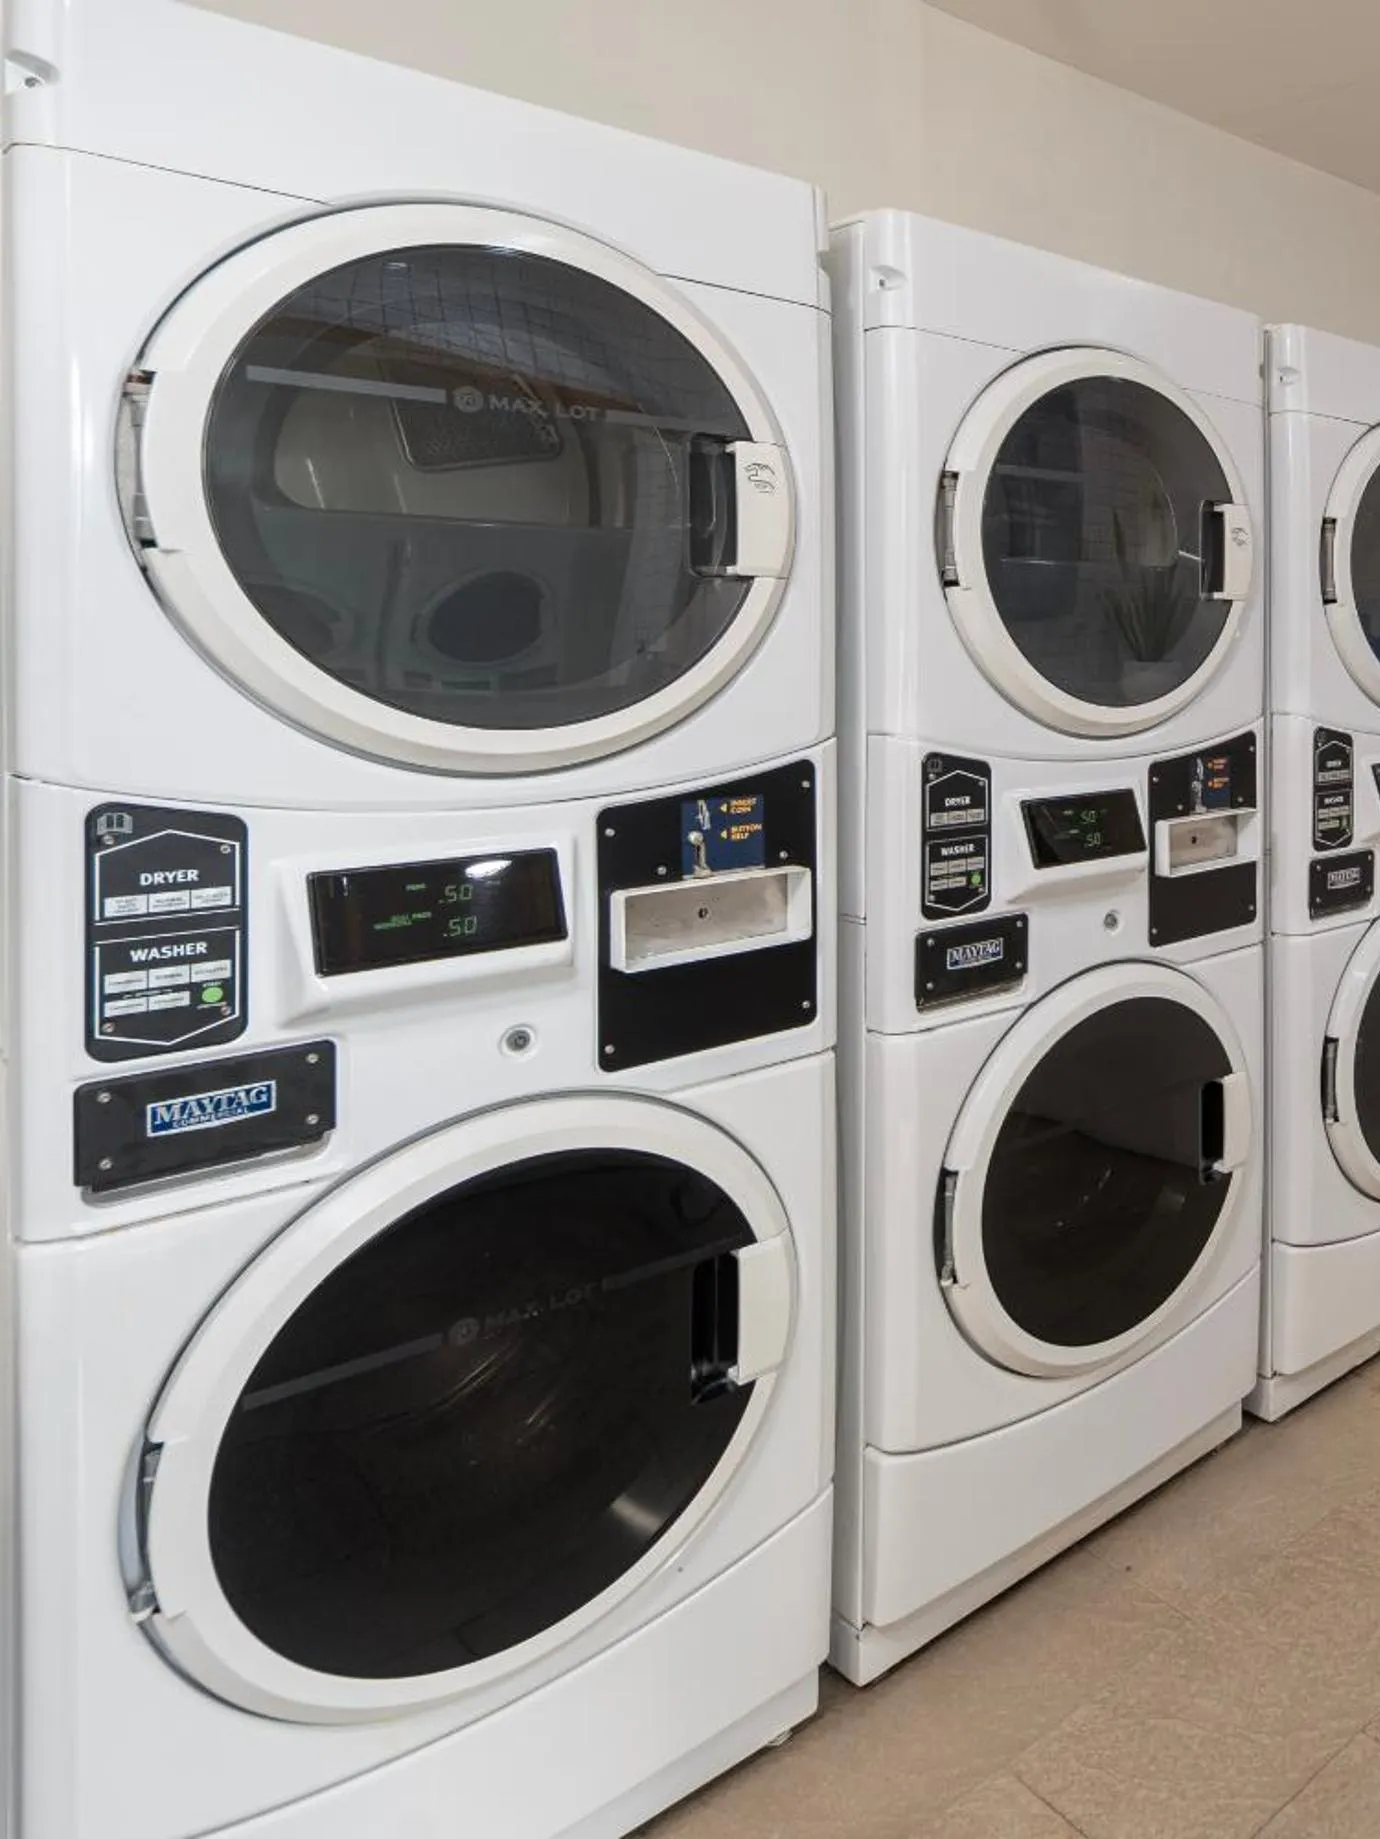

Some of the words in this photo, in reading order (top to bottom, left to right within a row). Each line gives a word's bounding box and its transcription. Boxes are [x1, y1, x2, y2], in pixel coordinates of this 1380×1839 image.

[555, 402, 599, 421] LOT
[139, 869, 200, 886] DRYER
[438, 883, 474, 905] .50
[442, 915, 478, 938] .50
[130, 941, 208, 963] WASHER
[949, 939, 1000, 962] MAYTAG
[154, 1085, 269, 1125] MAYTAG
